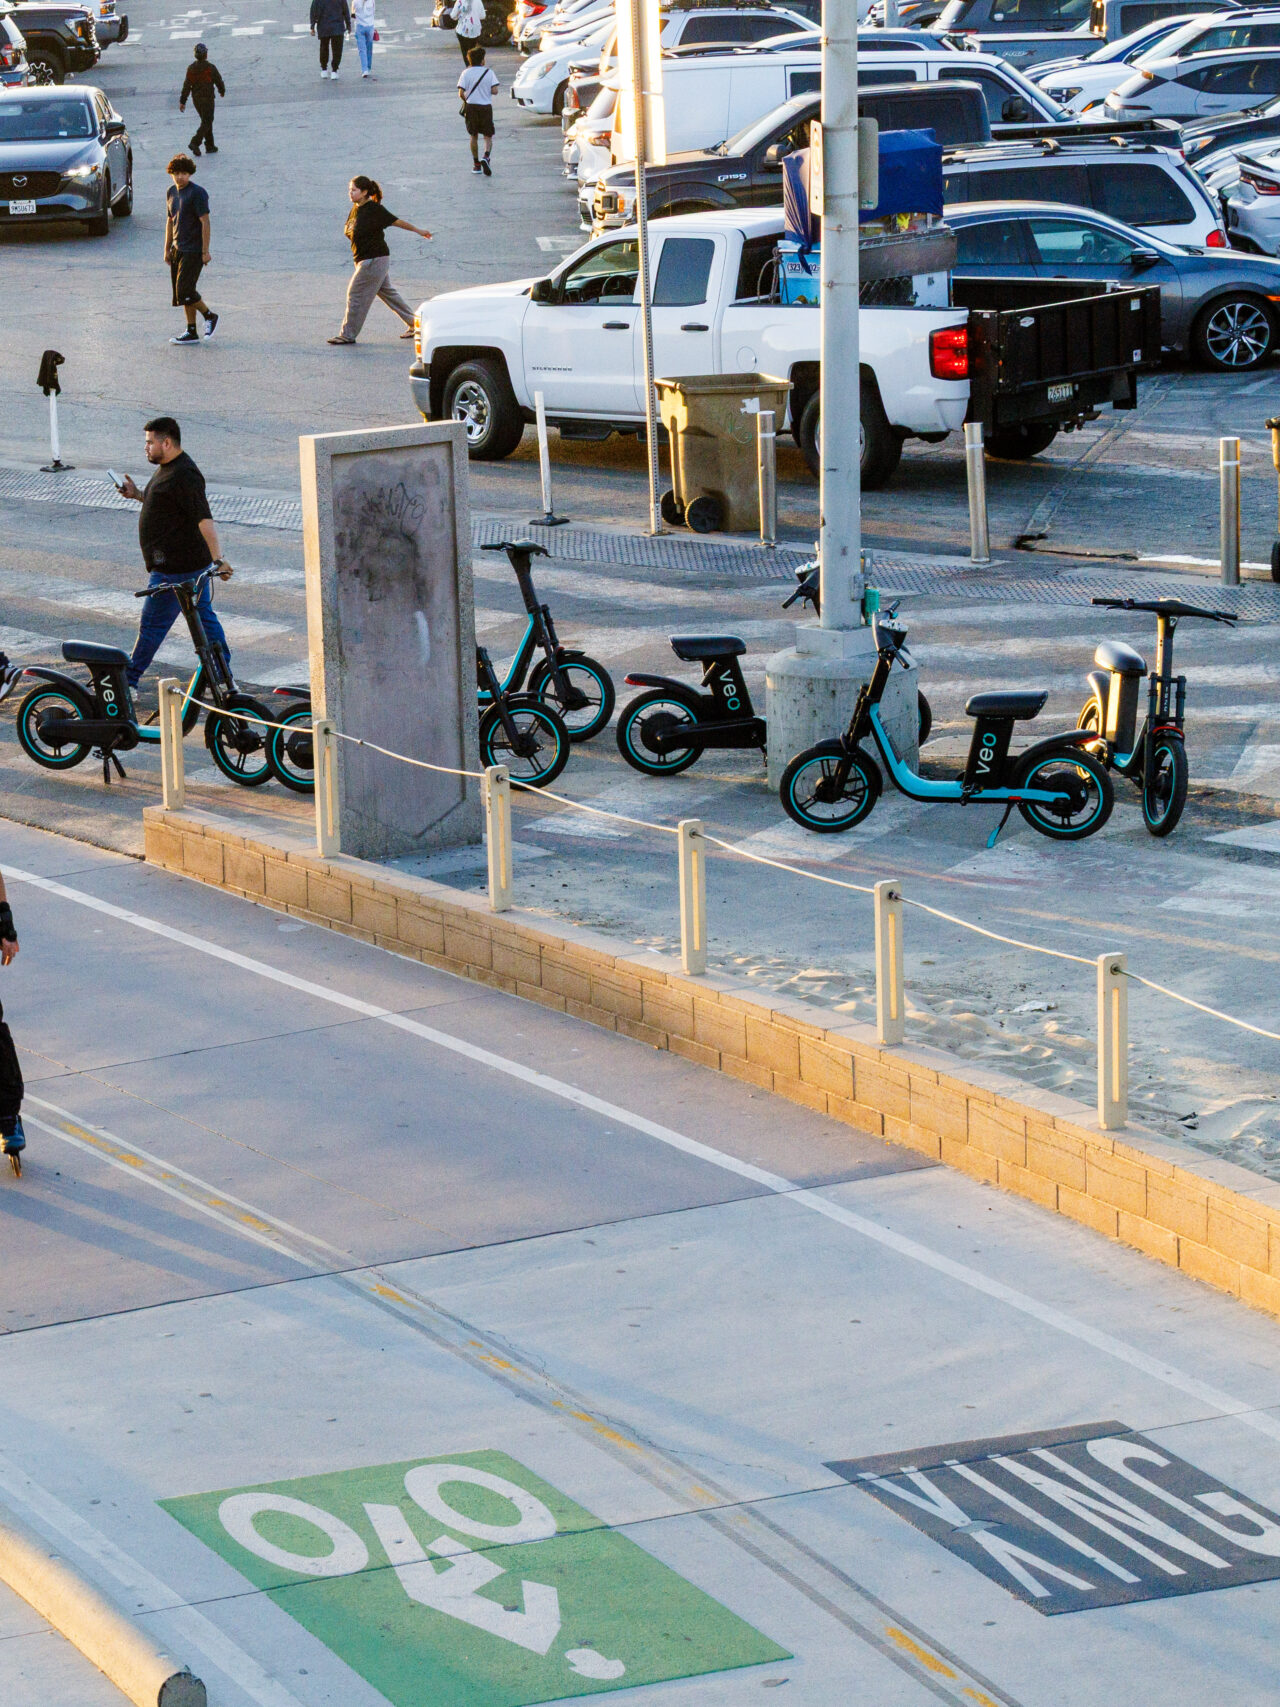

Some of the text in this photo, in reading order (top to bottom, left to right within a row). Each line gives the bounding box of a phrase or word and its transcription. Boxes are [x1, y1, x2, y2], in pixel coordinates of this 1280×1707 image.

[100, 674, 119, 717] veo
[719, 669, 741, 711] veo
[975, 732, 997, 774] veo
[857, 1437, 1280, 1598] XING
